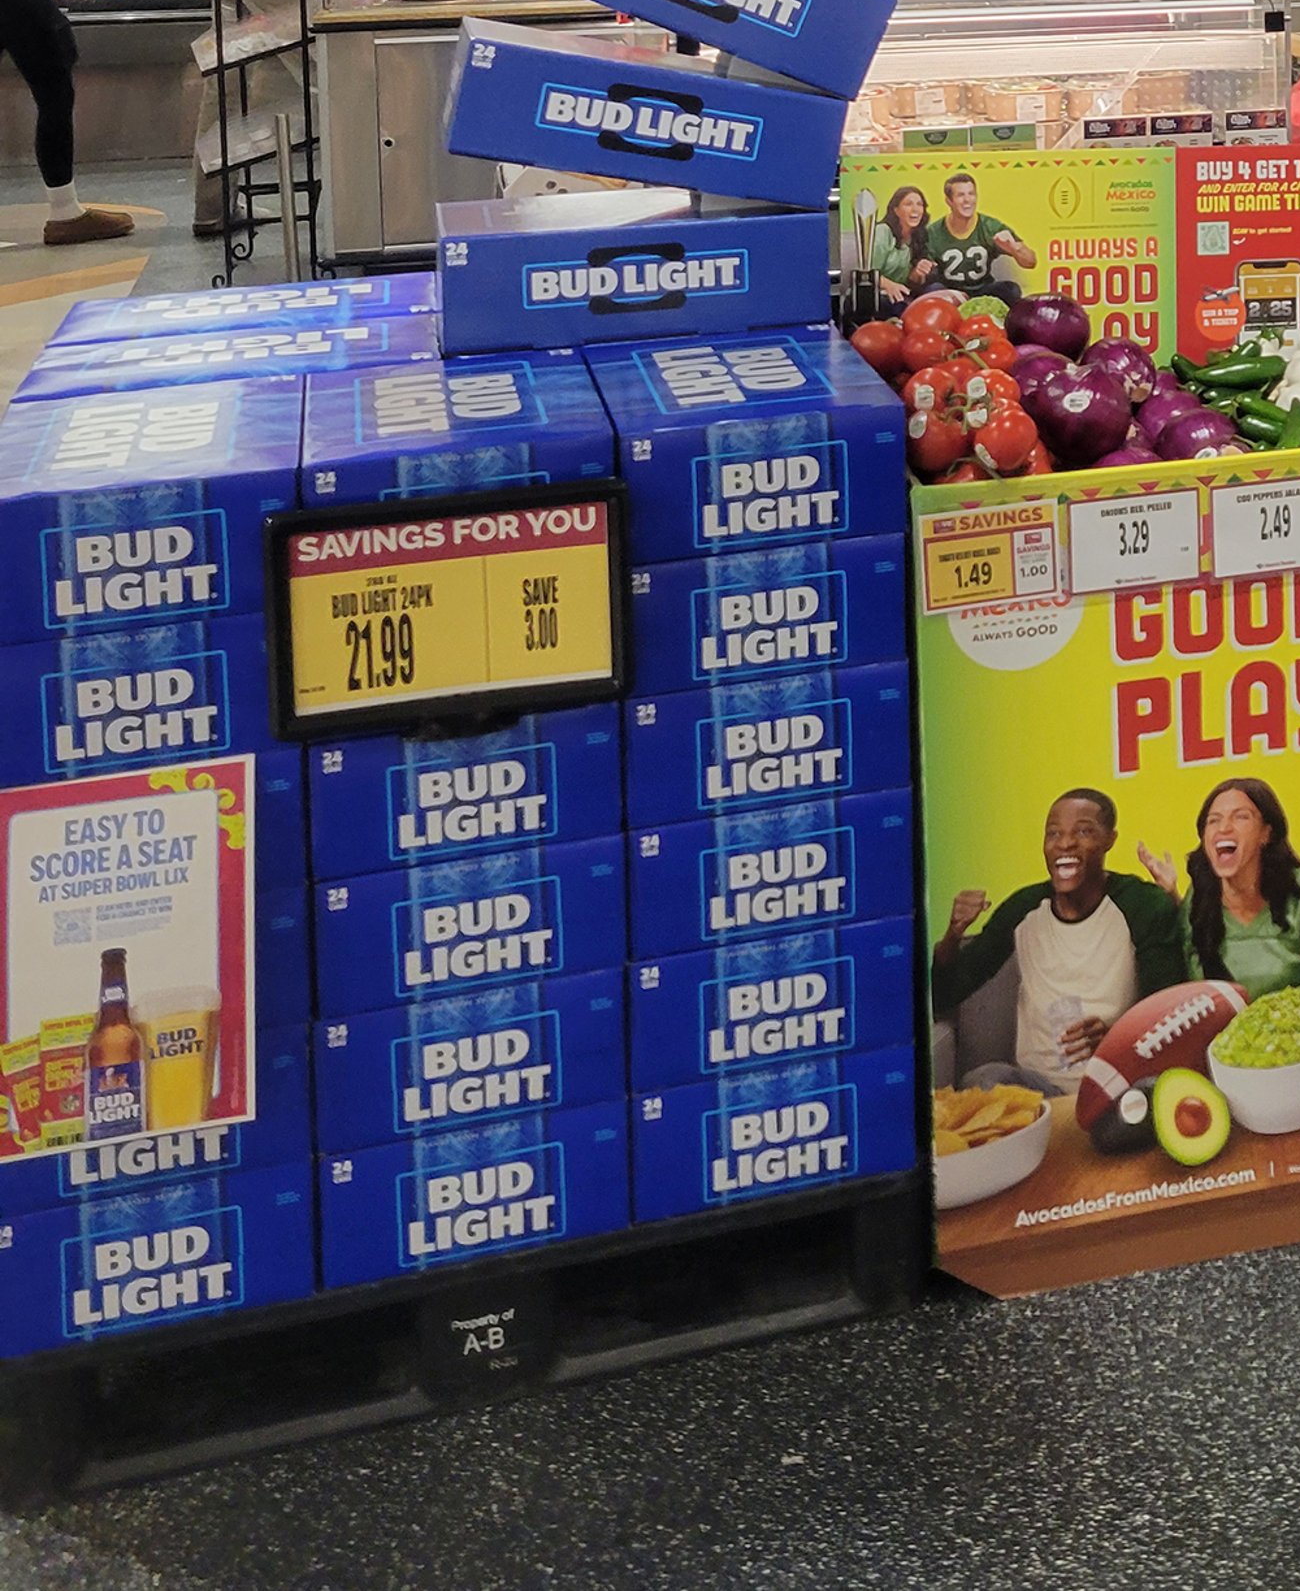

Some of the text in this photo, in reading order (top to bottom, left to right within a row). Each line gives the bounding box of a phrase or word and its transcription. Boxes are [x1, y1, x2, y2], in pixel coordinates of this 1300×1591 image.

[545, 91, 755, 152] BUD LIGHT
[1197, 161, 1233, 181] BUY
[1237, 160, 1251, 180] 4
[1256, 160, 1289, 180] GET
[1294, 159, 1300, 178] 1
[1198, 182, 1220, 194] AND
[1223, 181, 1255, 193] ENTER
[1258, 181, 1277, 192] FOR
[1279, 181, 1289, 191] A
[1197, 195, 1230, 213] WIN
[1234, 194, 1281, 212] GAME
[446, 243, 468, 257] 24
[942, 248, 985, 280] 23
[1049, 237, 1159, 260] ALWAYS A
[531, 257, 743, 300] BUD LIGHT
[1049, 263, 1159, 306] GOOD
[722, 455, 820, 498] BUD
[703, 490, 840, 538] LIGHT
[959, 507, 1043, 530] SAVINGS
[1260, 504, 1291, 540] 2.49
[76, 526, 194, 573] BUD
[298, 507, 597, 563] SAVINGS FOR YOU
[1119, 519, 1150, 556] 3.29
[955, 561, 993, 588] 1.49
[1020, 564, 1048, 578] 1.00
[55, 563, 218, 617] LIGHT
[331, 584, 433, 616] BUD LIGHT 24PK
[523, 575, 559, 606] SAVE
[525, 608, 558, 652] 3.00
[972, 624, 1058, 643] ALWAYS GOOD
[346, 615, 415, 690] 21.99
[419, 760, 525, 808] BUD
[64, 808, 165, 846] EASY TO
[399, 795, 547, 850] LIGHT
[30, 835, 197, 882] SCORE A SEAT
[38, 866, 189, 903] AT SUPER BOWL LIX
[728, 974, 827, 1021] BUD
[150, 1039, 203, 1059] LIGHT
[157, 1027, 197, 1045] BUD
[710, 1008, 845, 1064] LIGHT
[94, 1092, 134, 1110] BUD
[1014, 1165, 1256, 1228] AvocadosFromMexico.com
[452, 1309, 515, 1334] Property of
[463, 1328, 506, 1356] A-B
